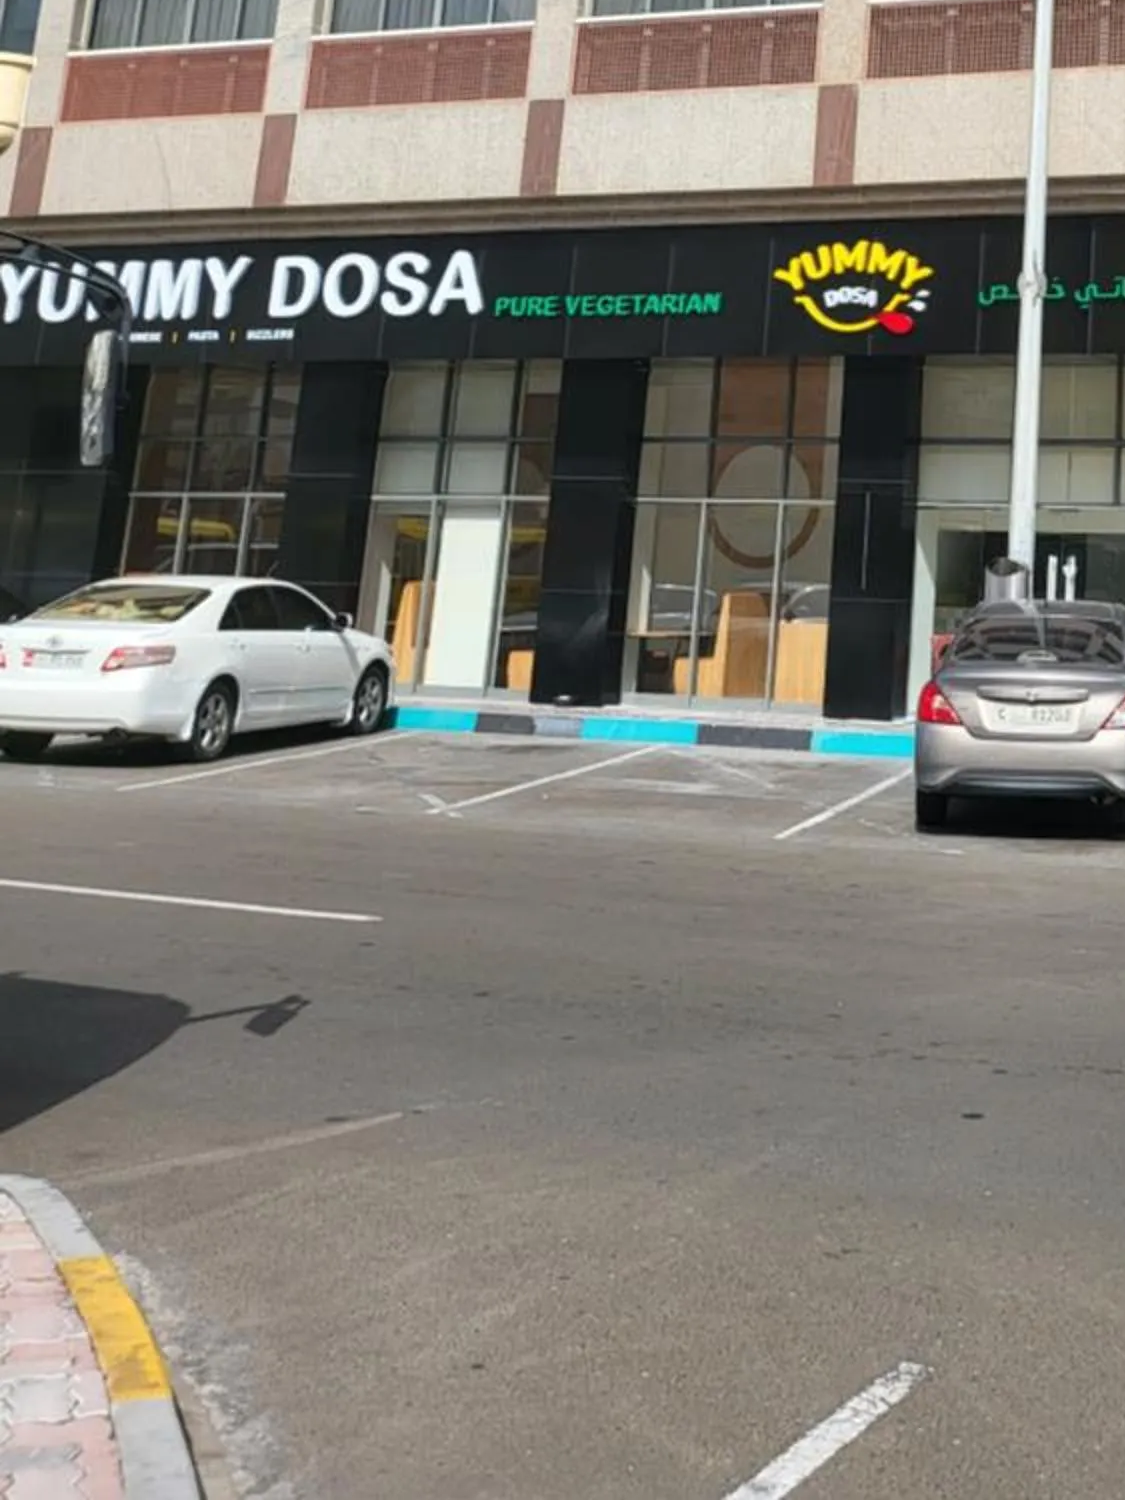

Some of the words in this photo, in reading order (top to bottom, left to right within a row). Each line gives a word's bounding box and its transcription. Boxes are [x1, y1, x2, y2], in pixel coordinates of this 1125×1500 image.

[773, 239, 934, 290] YUMMY
[268, 250, 483, 318] DOSA
[823, 285, 878, 308] DOSA
[494, 295, 560, 317] PURE
[564, 291, 723, 316] VEGETARIAN
